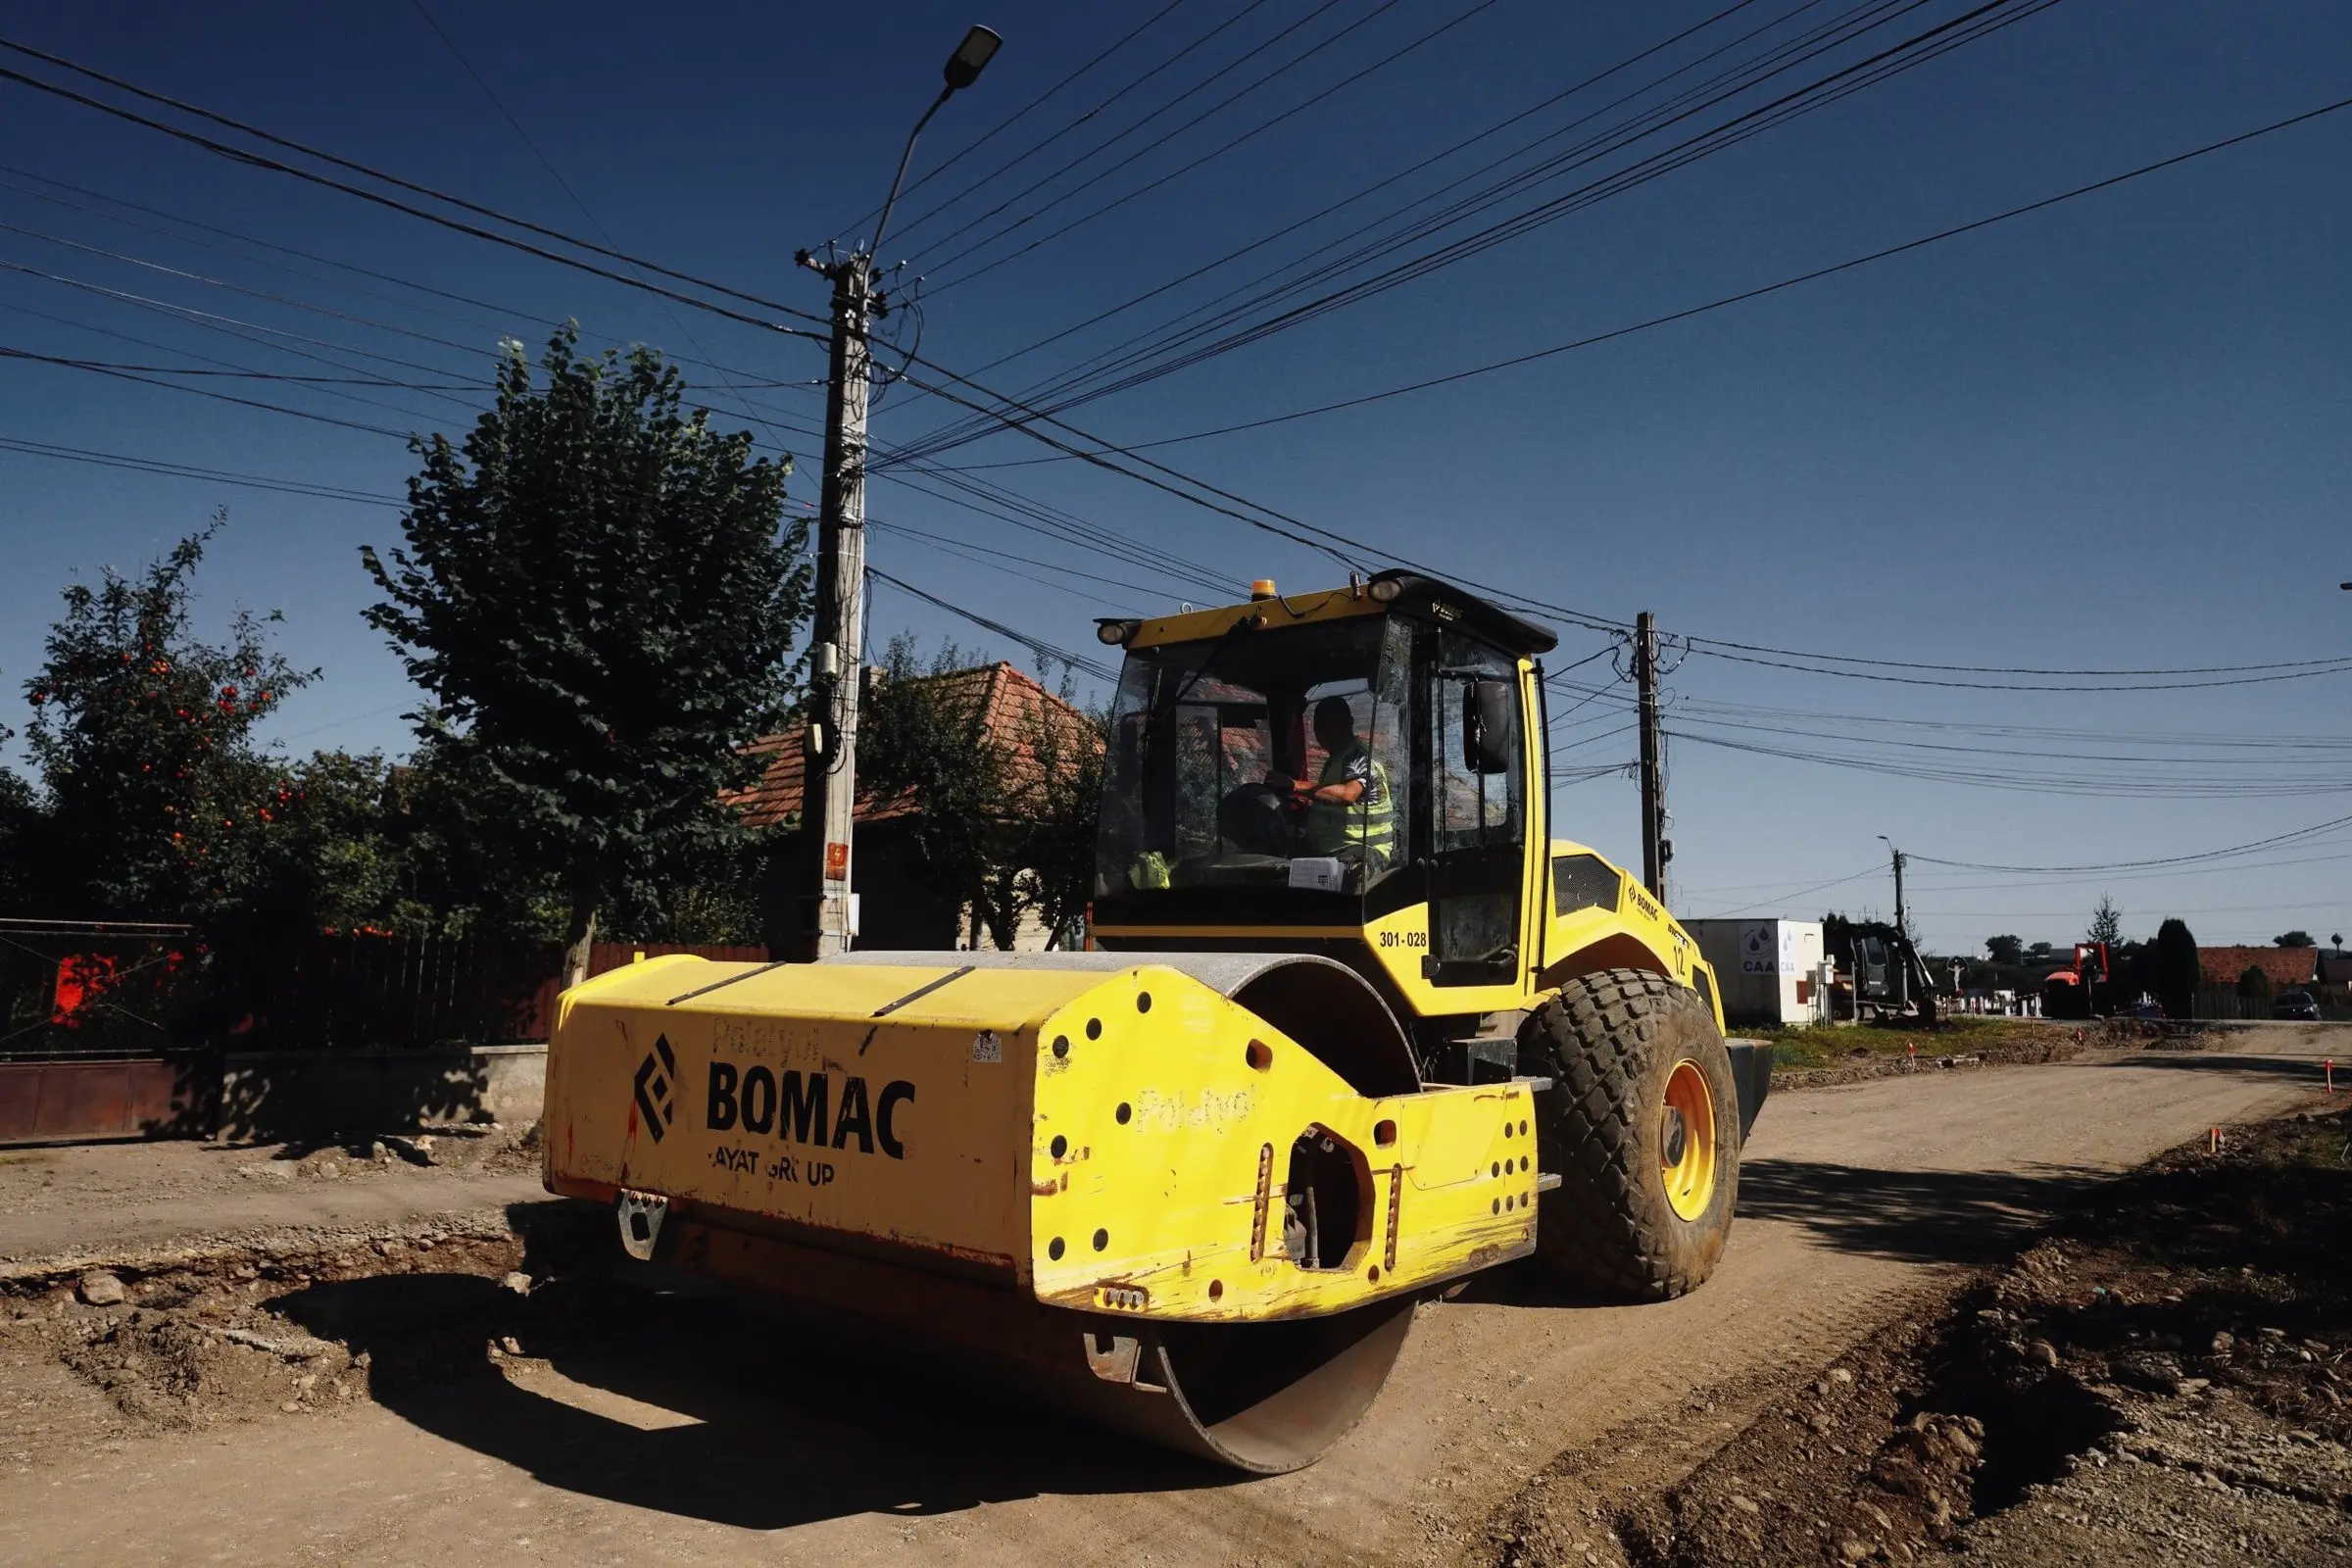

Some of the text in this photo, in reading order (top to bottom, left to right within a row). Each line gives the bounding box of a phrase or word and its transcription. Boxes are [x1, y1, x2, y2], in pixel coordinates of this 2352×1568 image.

[1380, 932, 1427, 948] 301-028
[1673, 945, 1686, 976] 12
[1743, 960, 1777, 973] CAA
[1780, 961, 1795, 973] CAA
[708, 1145, 760, 1175] AYAT
